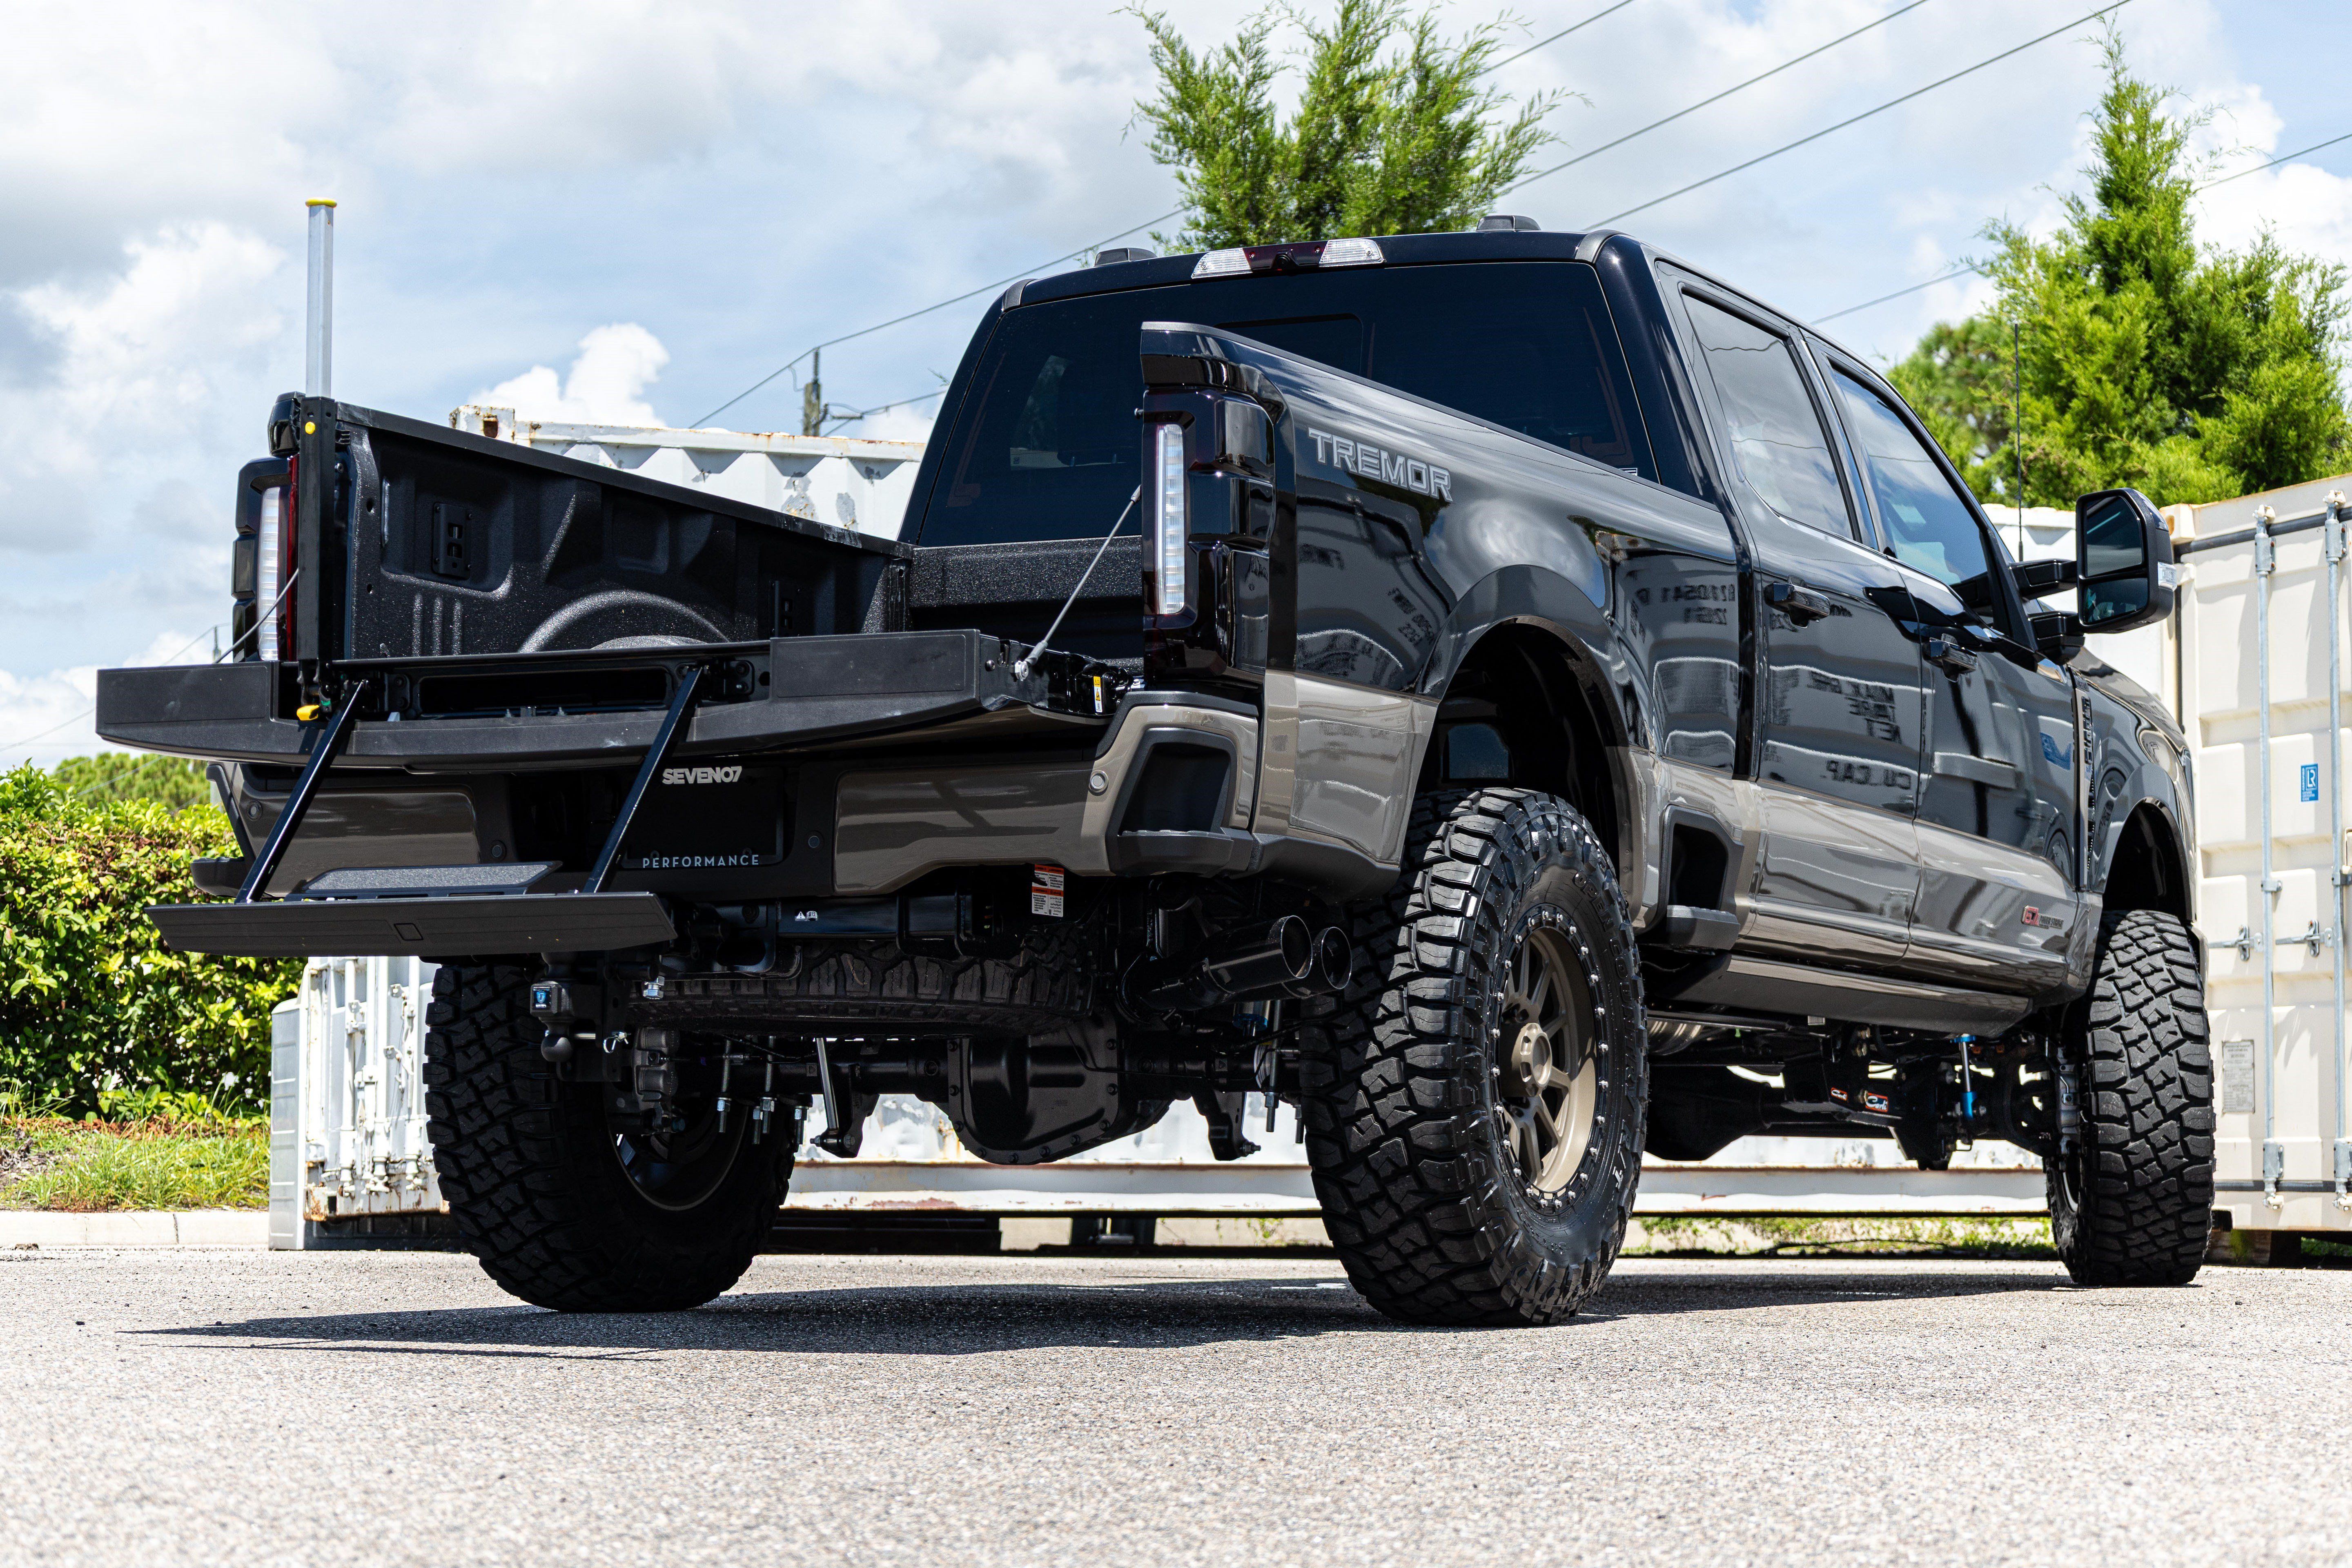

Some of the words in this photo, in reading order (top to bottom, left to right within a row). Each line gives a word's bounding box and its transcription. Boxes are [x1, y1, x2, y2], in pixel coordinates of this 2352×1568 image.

[1308, 427, 1454, 503] TREMOR
[643, 855, 760, 868] PERFORMANCE
[1573, 869, 1613, 932] OPEN
[1831, 1089, 1847, 1099] Carli
[1865, 1095, 1888, 1110] Carli
